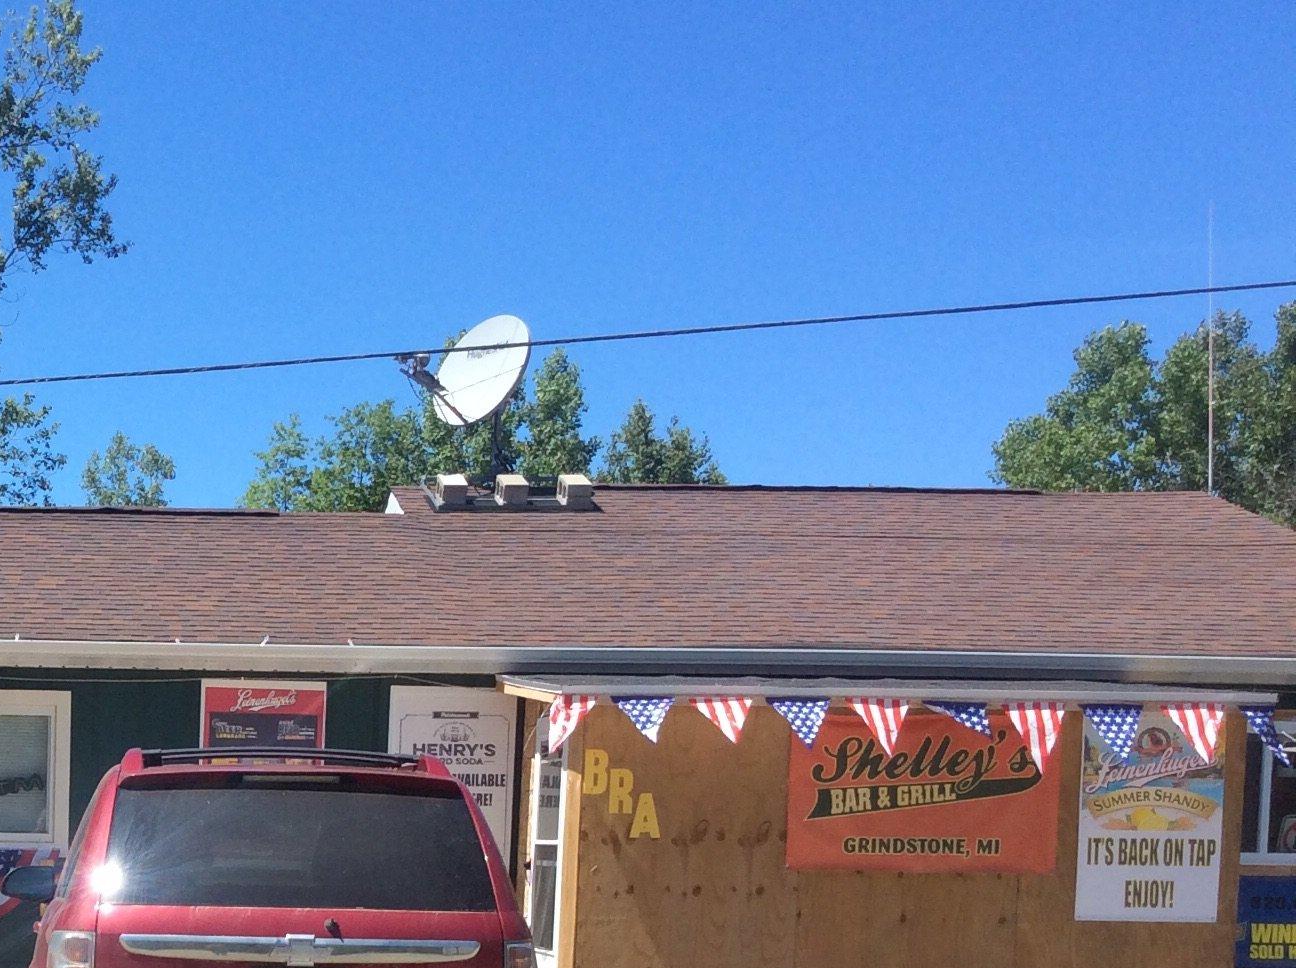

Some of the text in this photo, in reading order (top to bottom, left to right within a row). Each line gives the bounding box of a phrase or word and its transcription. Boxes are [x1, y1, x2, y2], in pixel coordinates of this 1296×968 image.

[412, 743, 496, 757] HENRY'S
[811, 729, 1037, 794] Shelley's
[452, 773, 506, 787] VAILABLE
[472, 793, 493, 806] RE!
[830, 782, 957, 815] BAR & GRILL
[1093, 789, 1210, 812] SUMMER SHANDY
[843, 836, 1001, 858] GRINDSTONE, MI
[1087, 837, 1217, 867] IT'S BACK ON TAP
[1124, 879, 1175, 909] ENJOY!
[1251, 922, 1296, 944] WIN
[1249, 944, 1284, 960] SOLD
